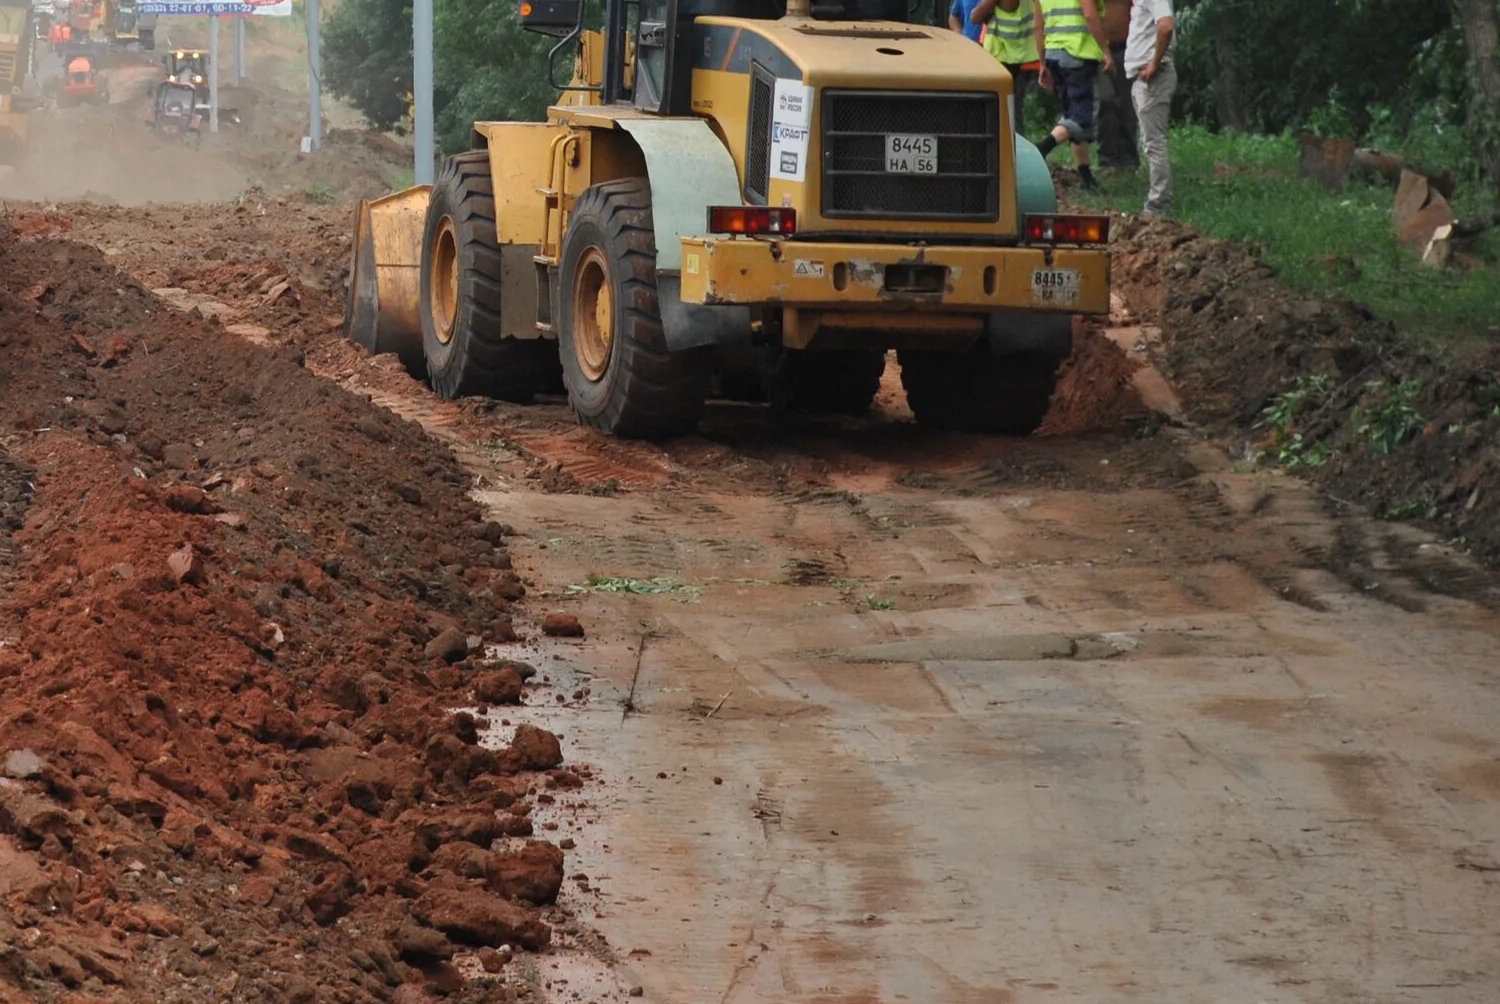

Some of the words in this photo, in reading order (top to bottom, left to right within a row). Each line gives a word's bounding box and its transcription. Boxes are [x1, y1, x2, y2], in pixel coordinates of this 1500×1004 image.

[892, 137, 931, 154] 8445
[890, 158, 908, 171] НА
[918, 159, 933, 171] 56
[1035, 272, 1064, 286] 8445
